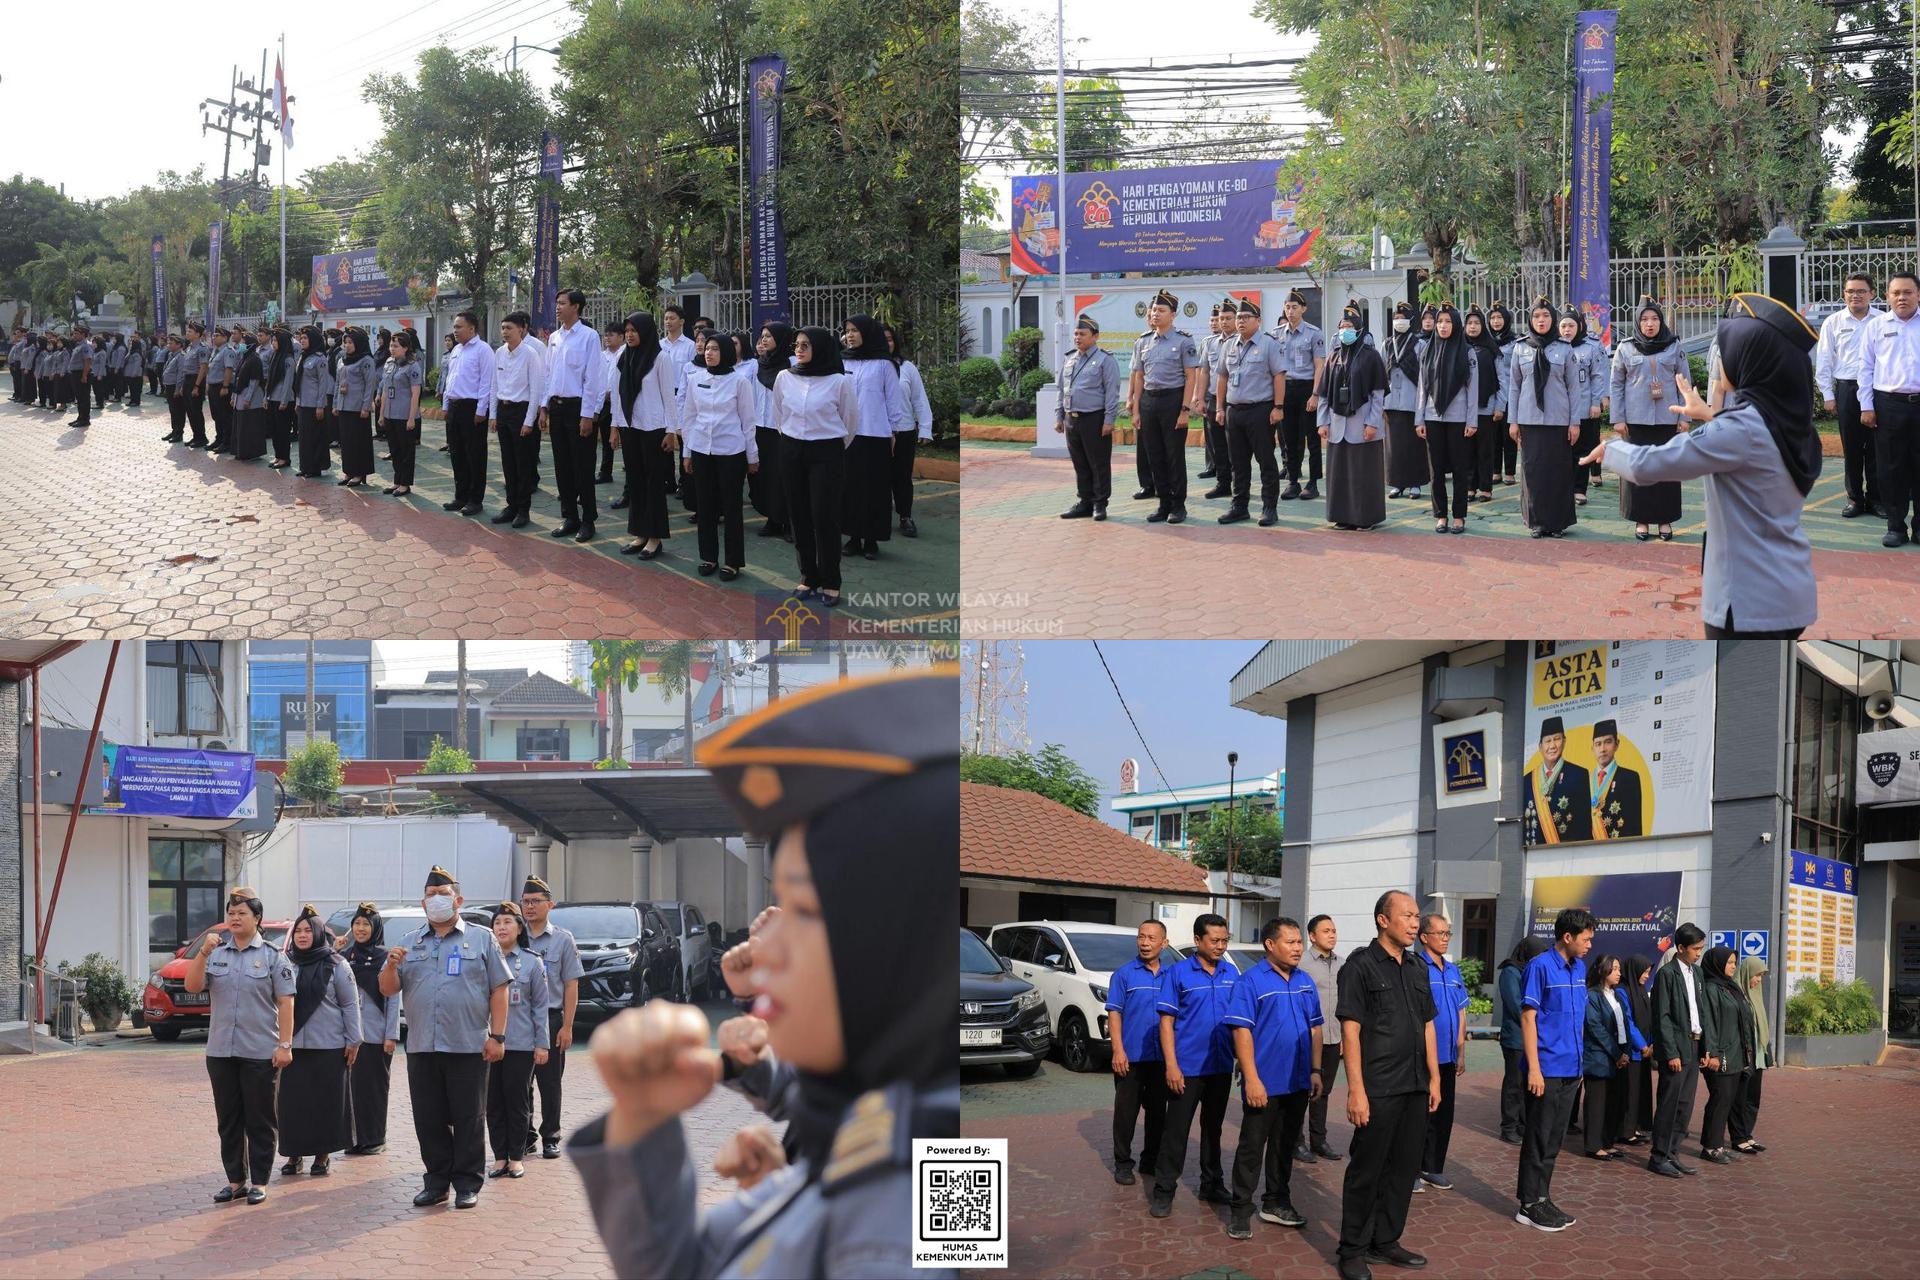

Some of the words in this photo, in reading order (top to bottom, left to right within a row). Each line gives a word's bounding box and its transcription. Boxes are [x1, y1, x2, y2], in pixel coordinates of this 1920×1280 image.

[1122, 185, 1144, 198] HARI
[1148, 180, 1215, 197] PENGAYOMAN
[1218, 178, 1247, 192] KE-80
[1123, 196, 1190, 212] KEMENTERIAN
[1193, 194, 1226, 208] HUKUM
[767, 210, 776, 237] HUKUM
[1123, 212, 1168, 225] REPUBLIK
[1171, 209, 1222, 224] INDONESIA
[760, 220, 768, 278] PENGAYOMAN
[767, 241, 777, 300] KEMENTERIAN
[760, 282, 768, 301] HARI
[1544, 650, 1602, 680] ASTA
[1550, 672, 1602, 700] CITA
[1872, 763, 1895, 772] WBK
[1712, 933, 1725, 948] P
[965, 1030, 983, 1039] 1220
[991, 1030, 1000, 1039] GM
